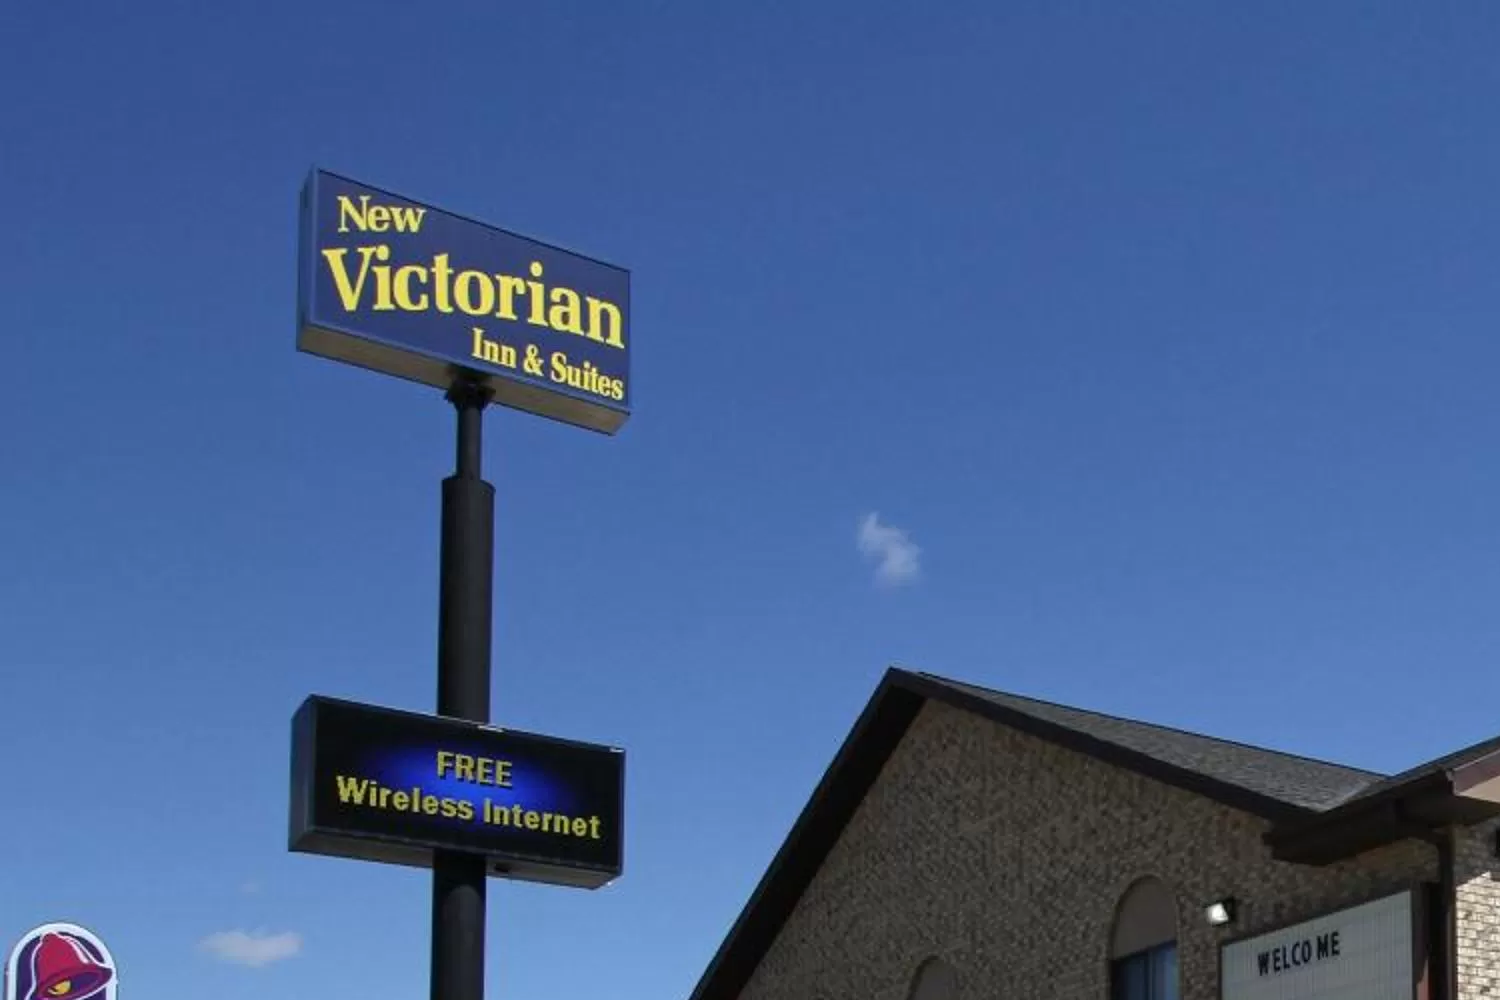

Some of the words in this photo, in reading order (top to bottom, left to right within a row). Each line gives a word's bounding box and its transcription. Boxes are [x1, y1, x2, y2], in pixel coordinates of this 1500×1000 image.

[337, 195, 427, 234] New
[321, 245, 625, 350] Victorian
[471, 327, 518, 370] Inn
[523, 344, 545, 377] &
[551, 352, 625, 401] Suites
[436, 750, 514, 788] FREE
[336, 774, 475, 821] Wireless
[484, 798, 602, 840] Internet
[1257, 931, 1341, 977] WELCOME
